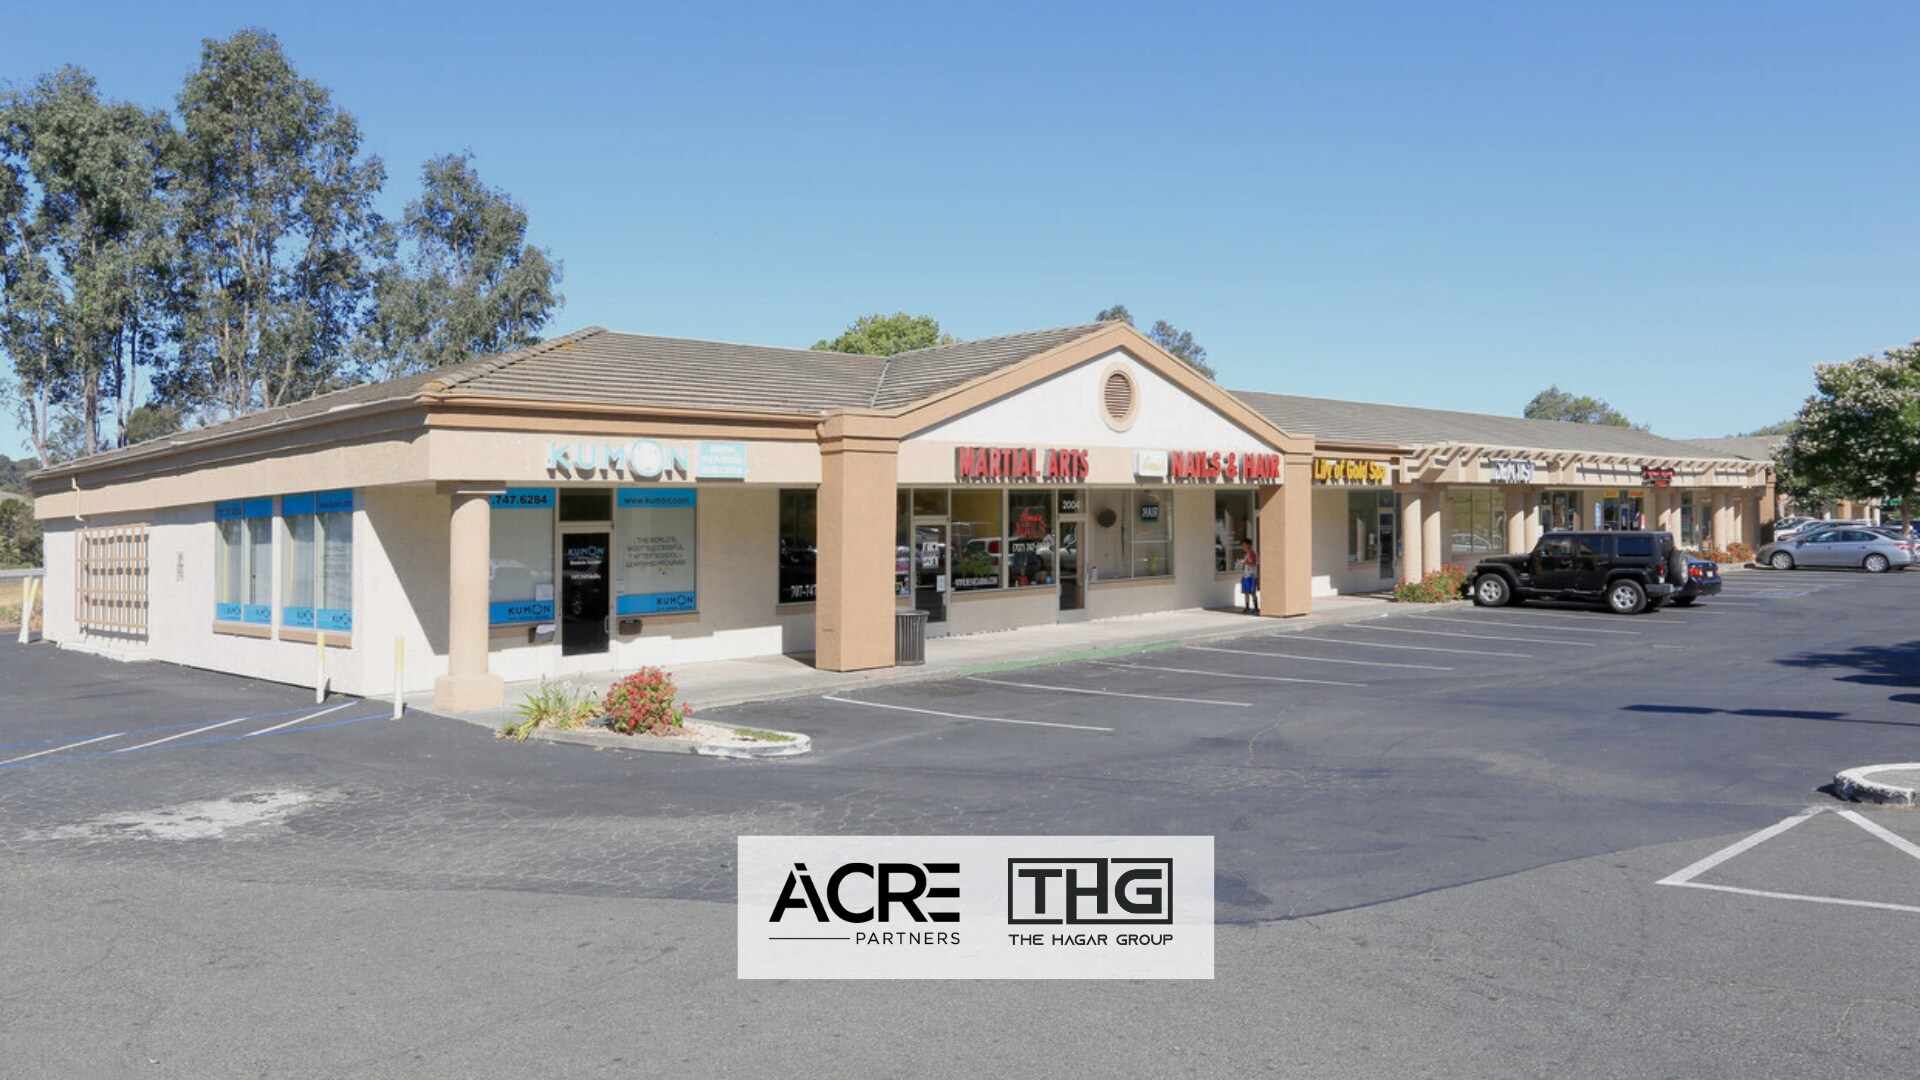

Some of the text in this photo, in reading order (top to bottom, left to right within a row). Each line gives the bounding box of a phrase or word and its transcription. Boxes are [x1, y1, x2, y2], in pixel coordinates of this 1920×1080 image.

[550, 438, 689, 478] KUMON
[959, 446, 1089, 479] MARTIAL ARTS
[1171, 450, 1221, 478] NAILS
[1226, 452, 1238, 478] &
[1243, 453, 1280, 478] HAIR
[1314, 458, 1332, 482] Lily
[1334, 459, 1344, 479] of
[1346, 459, 1368, 480] Gold
[490, 495, 548, 505] .747.6284
[1062, 500, 1080, 509] 2004
[568, 545, 604, 556] KUMON
[656, 594, 694, 606] KUMON
[508, 604, 551, 616] KUMON
